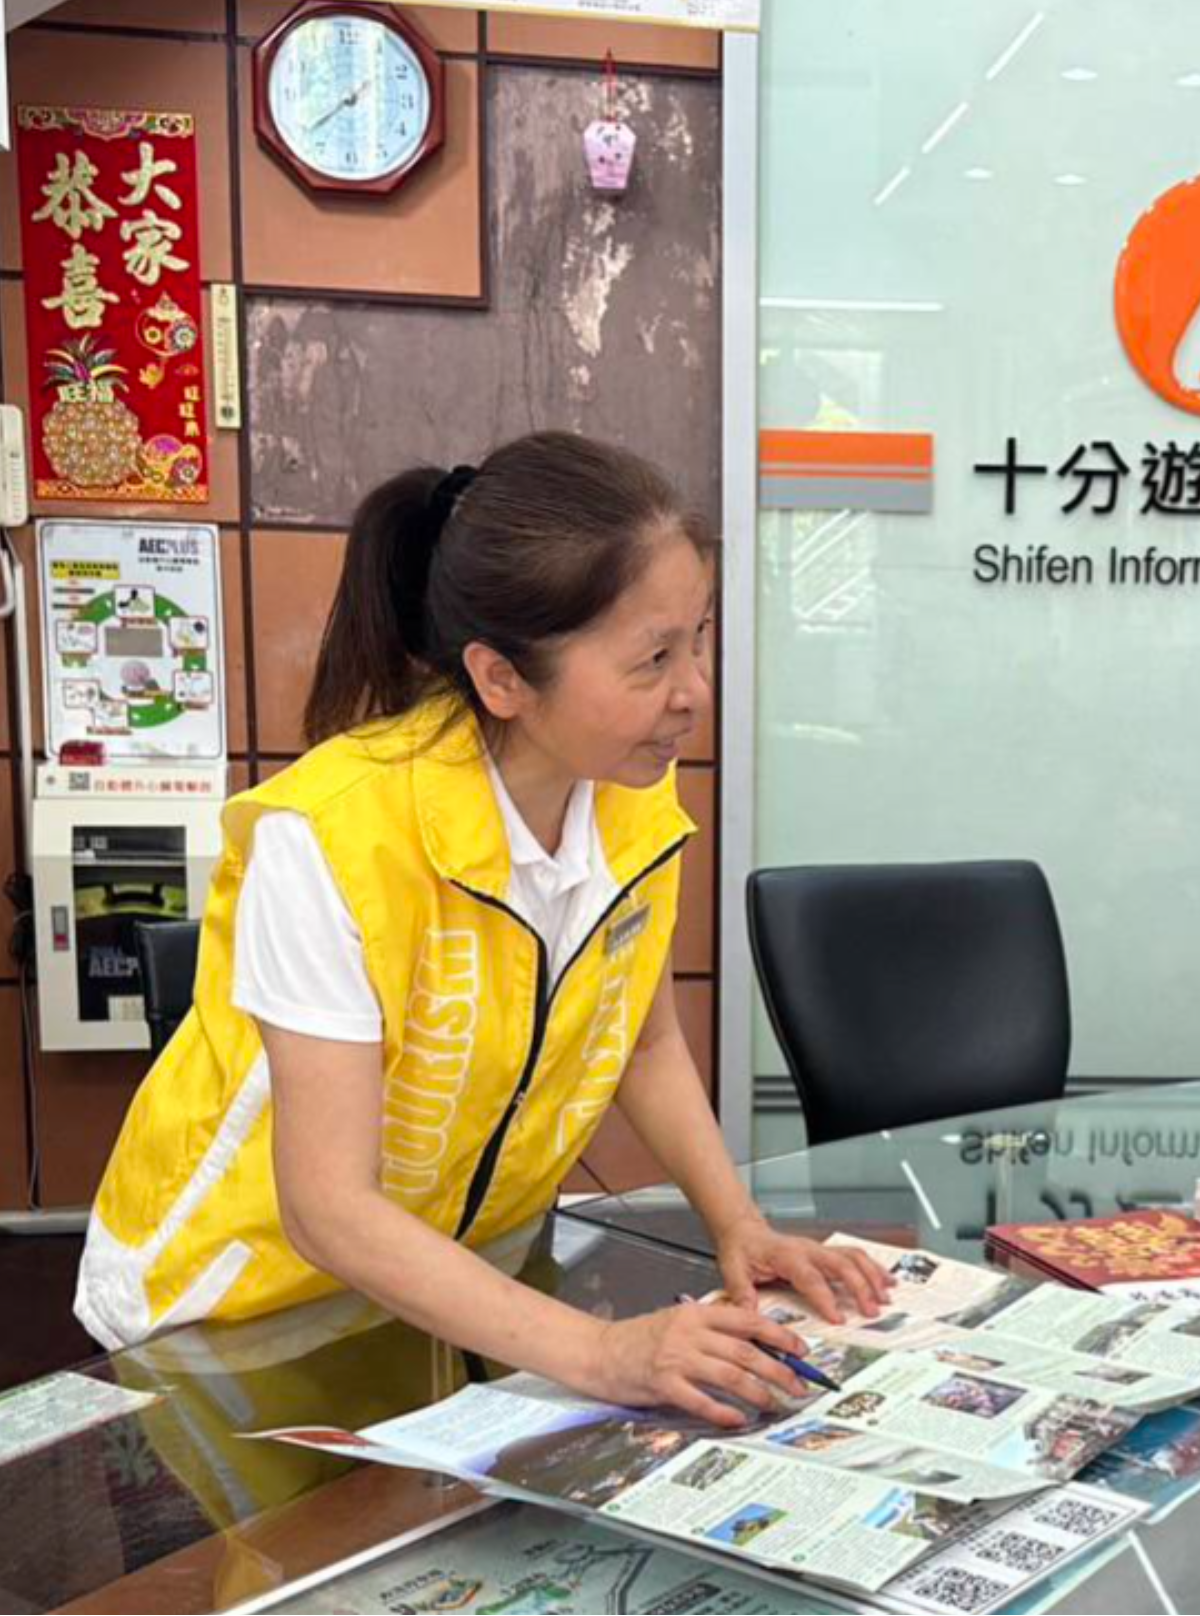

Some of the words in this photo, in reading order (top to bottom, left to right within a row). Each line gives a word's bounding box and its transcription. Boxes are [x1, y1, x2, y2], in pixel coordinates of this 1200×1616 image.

[31, 149, 121, 330] 恭喜
[117, 141, 191, 286] 大家
[973, 545, 1094, 586] Shifen
